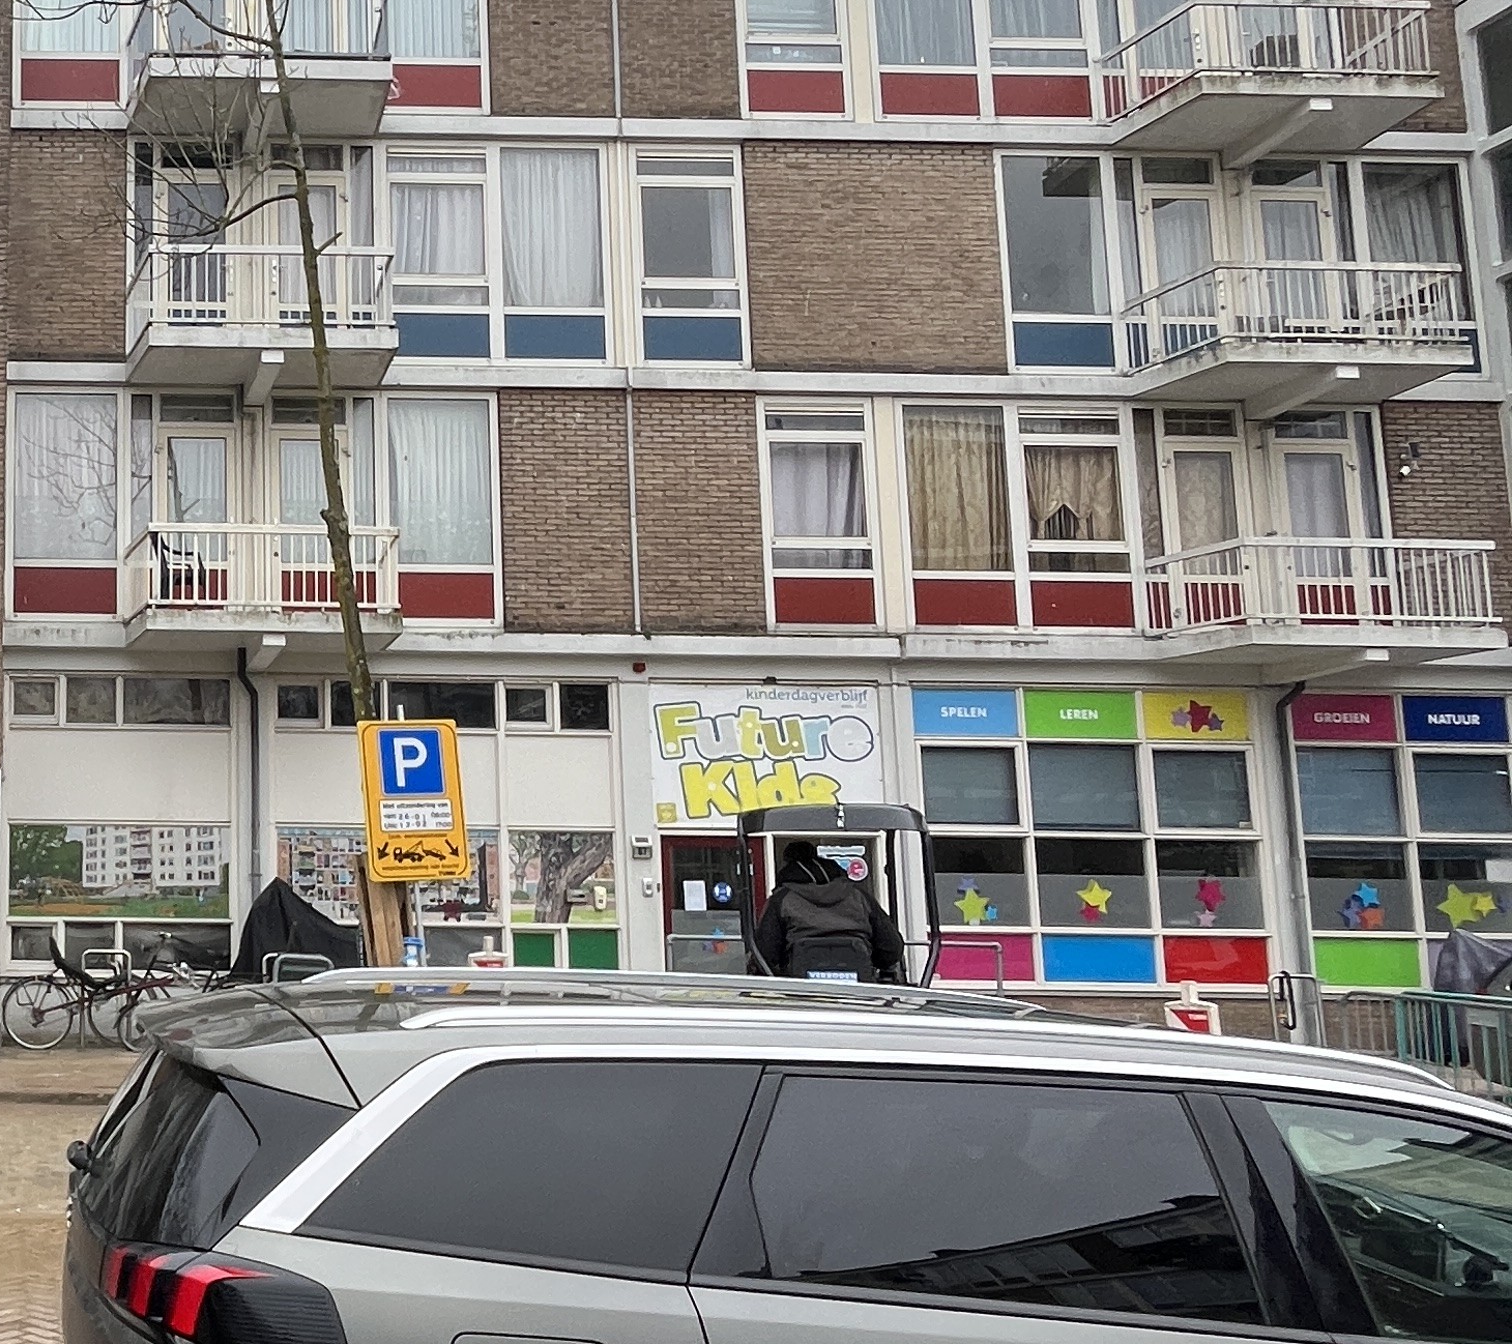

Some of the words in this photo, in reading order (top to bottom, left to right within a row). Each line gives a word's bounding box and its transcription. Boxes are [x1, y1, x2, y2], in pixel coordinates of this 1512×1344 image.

[746, 688, 868, 704] kinderdagverblijf
[940, 706, 988, 718] SPELEN
[1059, 709, 1099, 720] LEREN
[1313, 712, 1370, 724] GROEIEN
[1427, 714, 1481, 726] NATUUR
[654, 701, 874, 762] Future
[393, 737, 428, 787] P
